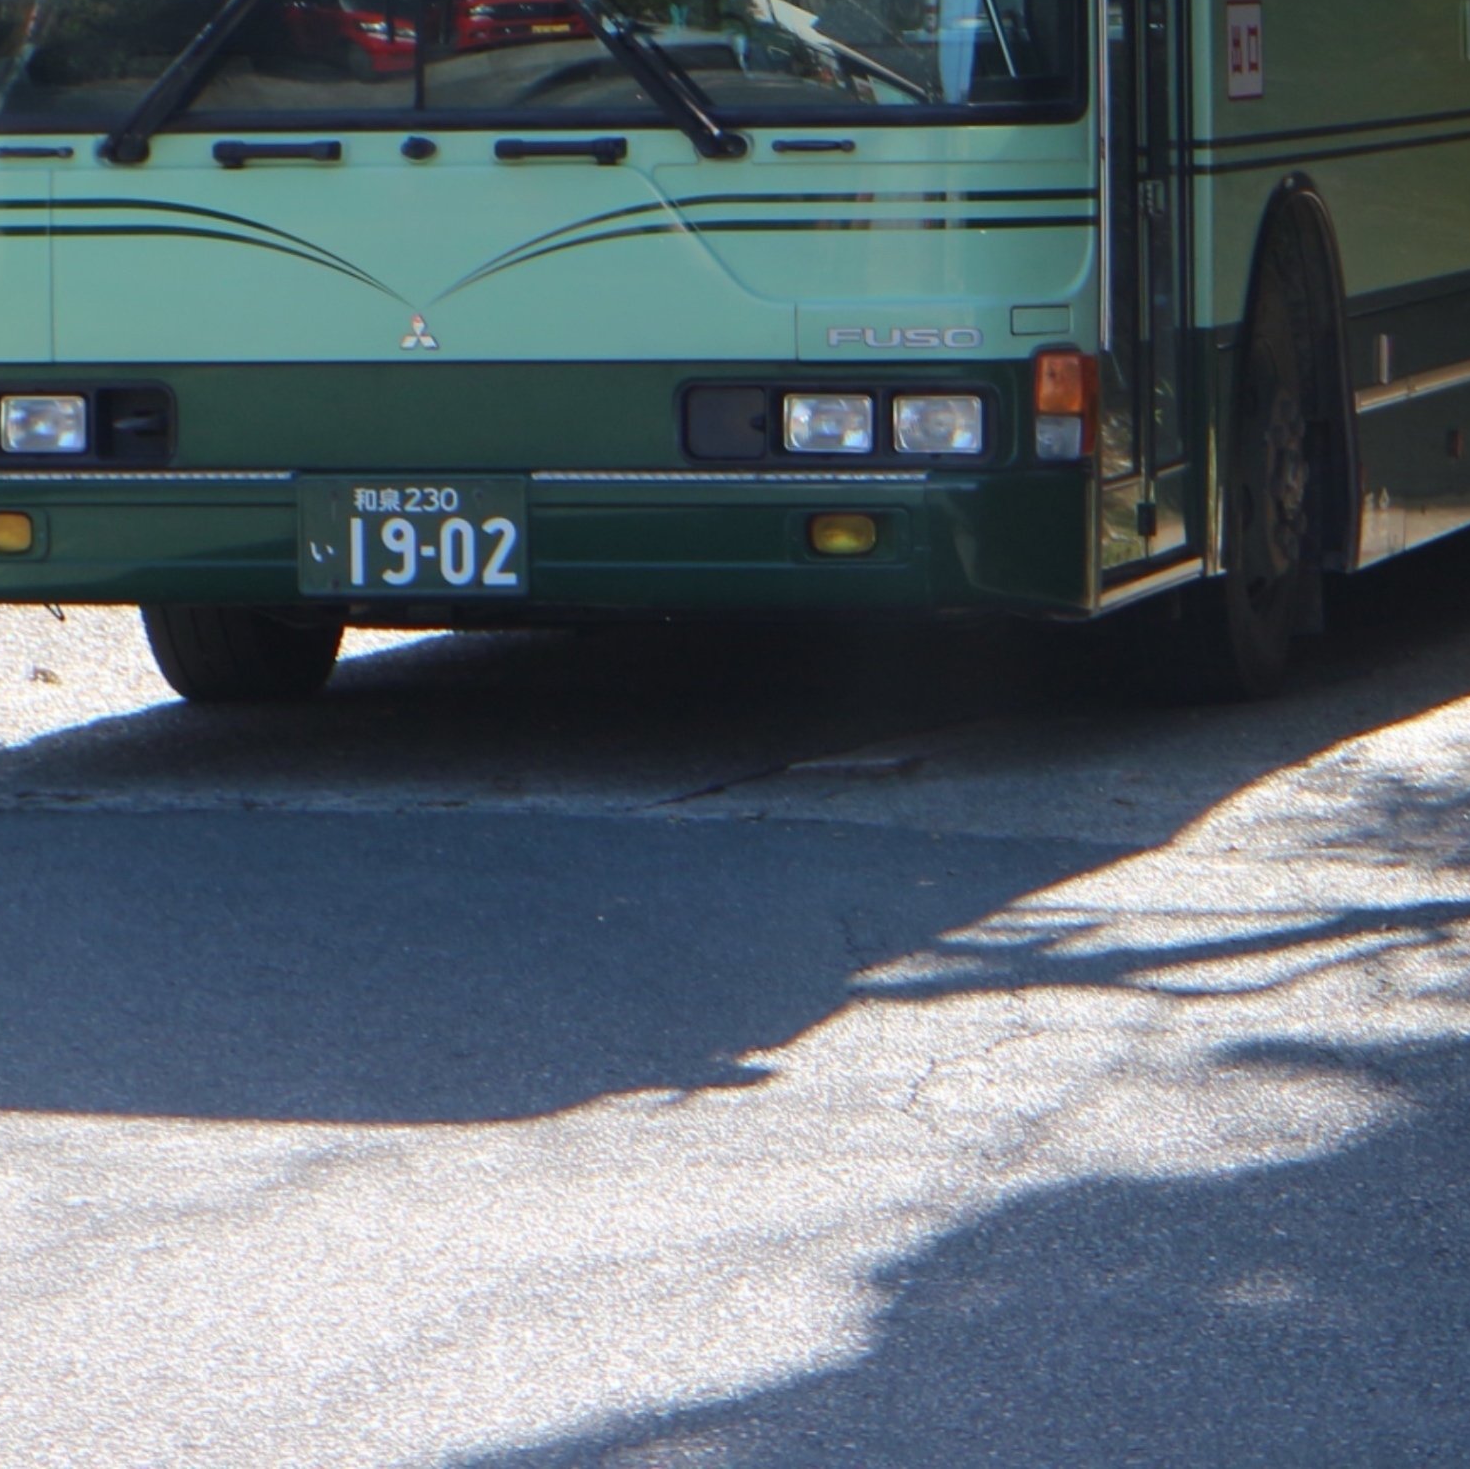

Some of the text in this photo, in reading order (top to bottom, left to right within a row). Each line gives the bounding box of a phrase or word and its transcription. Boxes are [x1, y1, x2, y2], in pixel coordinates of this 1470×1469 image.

[1231, 24, 1259, 73] 出口
[827, 327, 984, 349] FUSO
[309, 516, 519, 586] い 19-02
